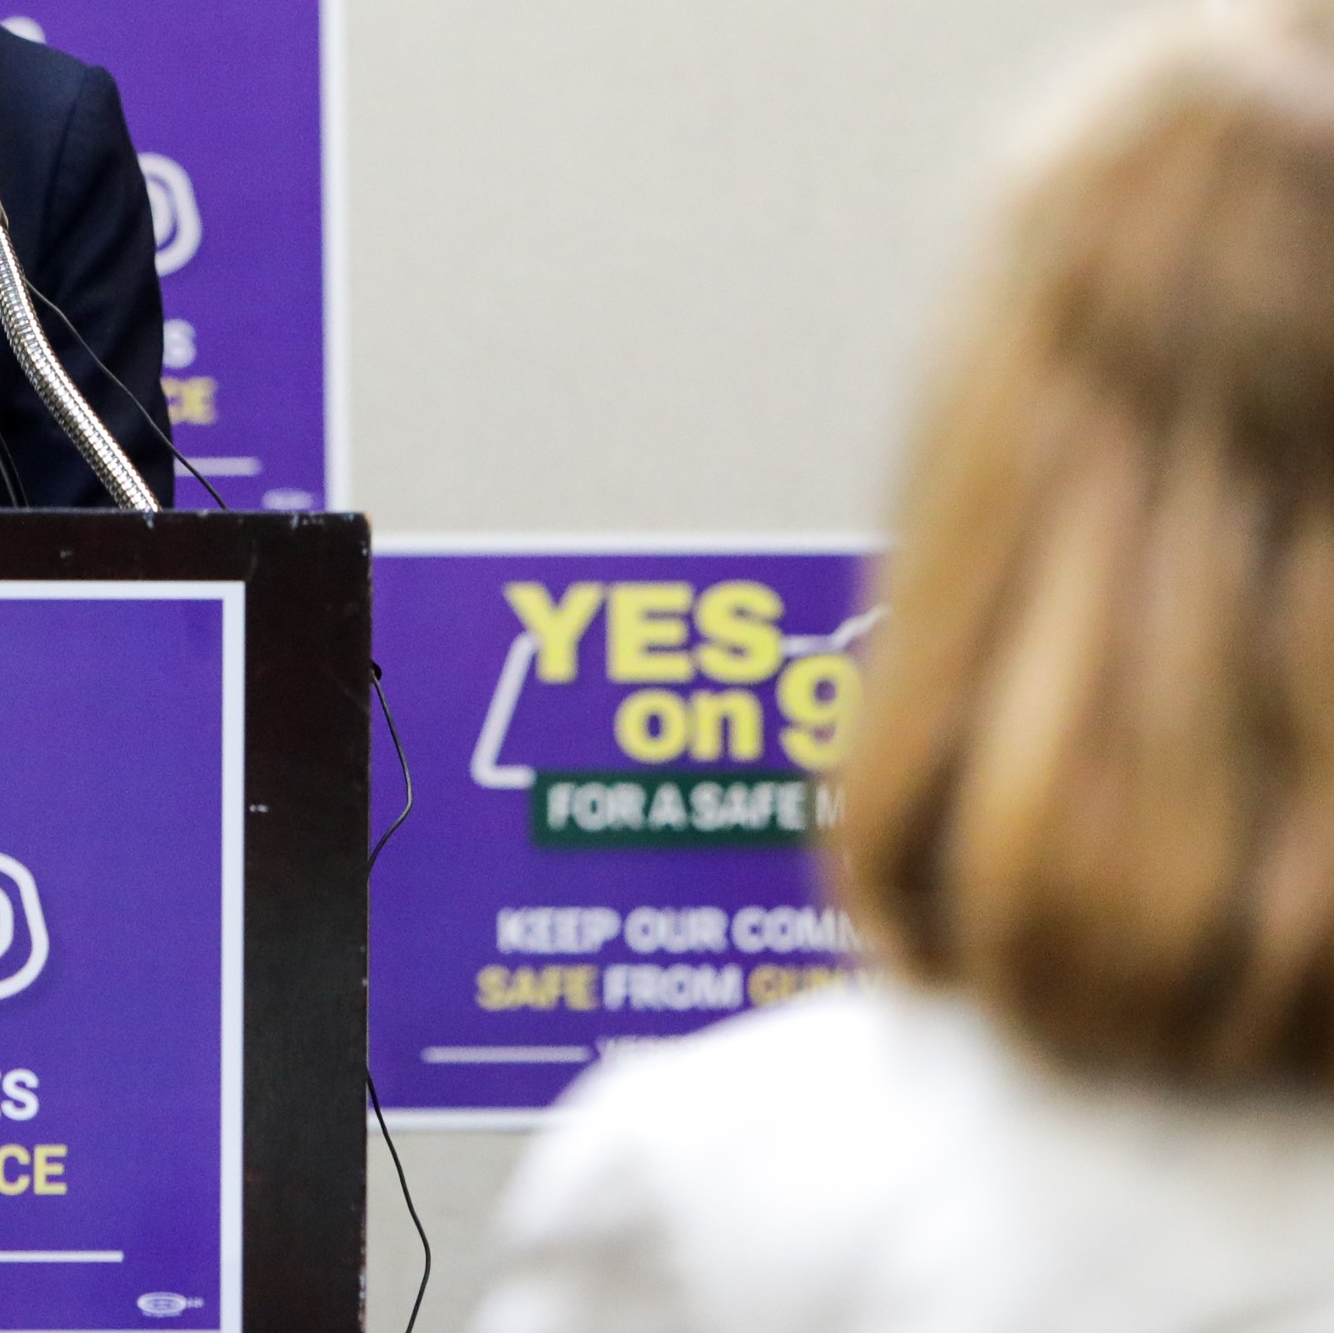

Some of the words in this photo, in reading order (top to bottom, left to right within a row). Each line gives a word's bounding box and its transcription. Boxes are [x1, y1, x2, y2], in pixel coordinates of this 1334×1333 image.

[504, 582, 784, 684] YES
[615, 690, 763, 764] on
[777, 653, 865, 770] 9
[547, 783, 646, 831] FOR
[650, 783, 684, 831] A
[690, 782, 806, 831] SAFE
[497, 907, 621, 954] KEEP
[624, 907, 728, 954] OUR
[476, 966, 597, 1011] SAFE
[603, 966, 743, 1011] FROM
